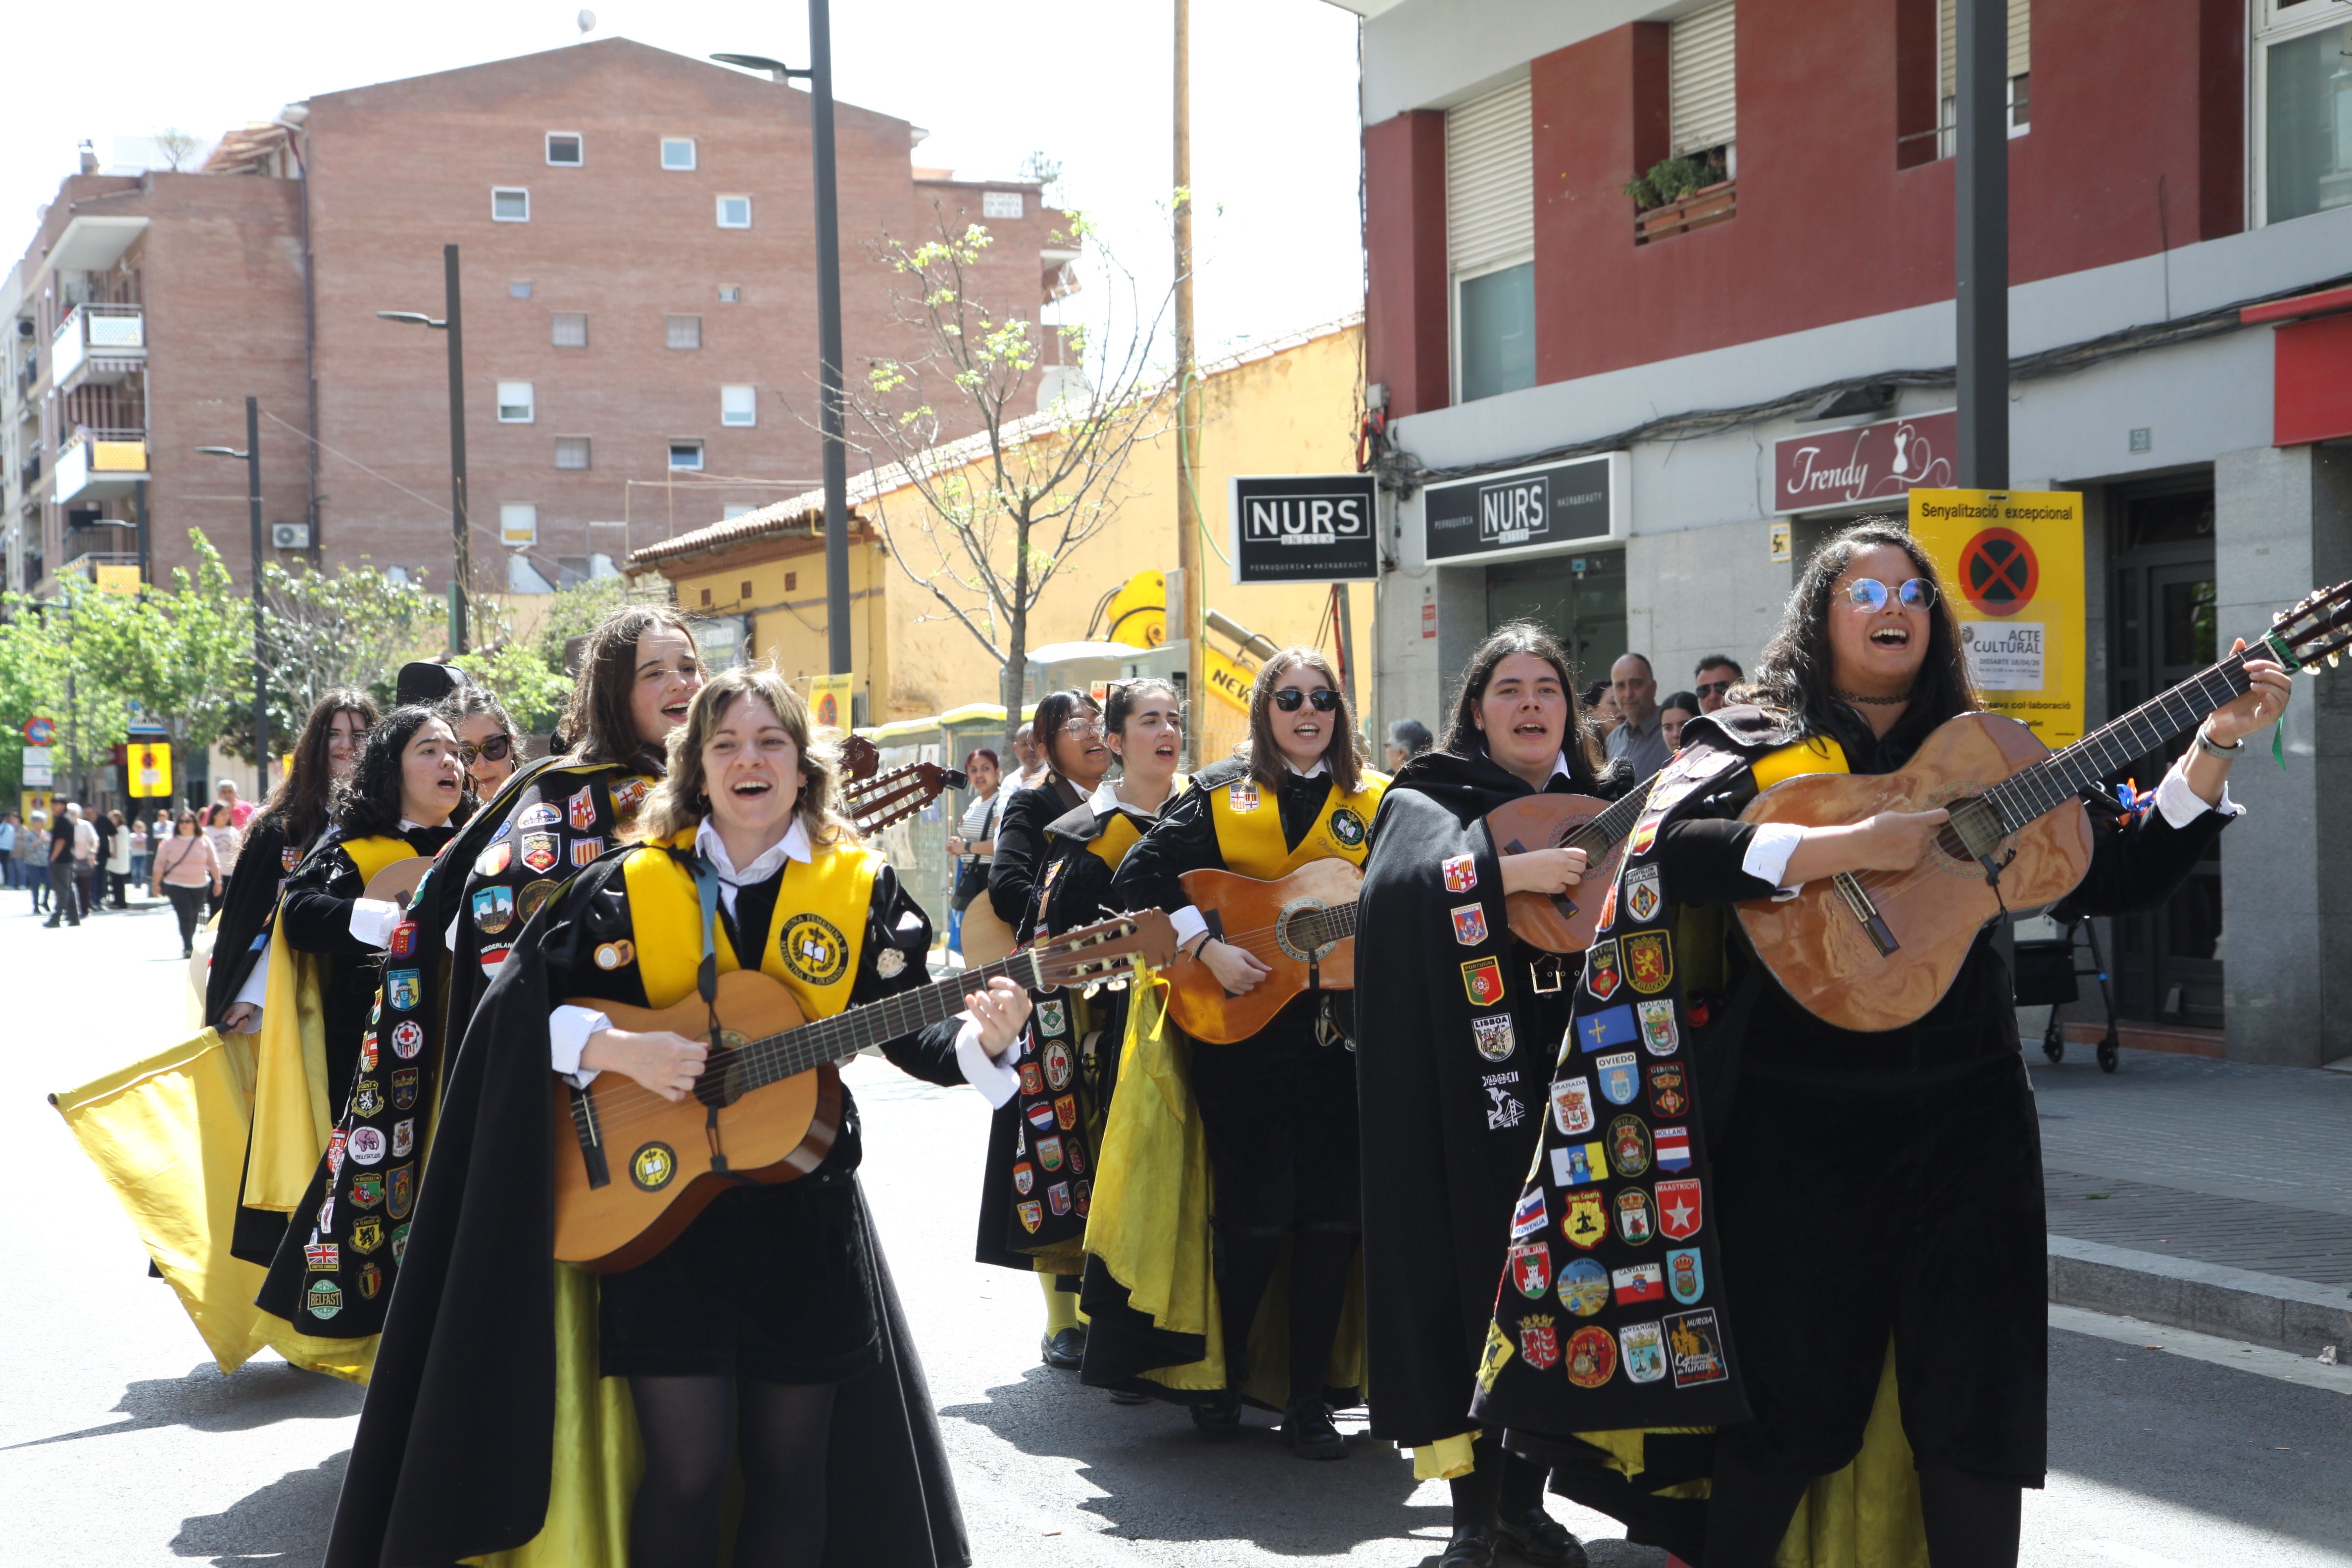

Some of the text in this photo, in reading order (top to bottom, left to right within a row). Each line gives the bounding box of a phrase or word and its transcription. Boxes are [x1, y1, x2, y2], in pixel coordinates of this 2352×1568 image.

[1787, 429, 1870, 501] Trendy
[1557, 492, 1602, 507] HAIR&BEAUTY
[1484, 485, 1543, 534] NURS
[1922, 502, 2072, 522] Senyalització excepcional
[1253, 499, 1360, 536] NURS
[1435, 516, 1473, 530] PERRUQUERIA
[1283, 535, 1331, 543] UNISEX
[2009, 630, 2040, 642] ACTE
[1974, 640, 2041, 654] CULTURAL
[2011, 701, 2071, 709] col·laboració
[807, 914, 843, 943] FEMENINA
[480, 942, 513, 954] NEDERLAN
[1590, 944, 1616, 959] SITGES
[781, 940, 803, 979] MEDICINA
[1465, 960, 1493, 970] PORTUGAL
[1634, 974, 1669, 991] ZARAGOZA
[1640, 999, 1671, 1009] MALAGA
[1475, 1016, 1508, 1028] LISBOA
[1598, 1054, 1634, 1067] OVIEDO
[1651, 1065, 1679, 1074] GIRONA
[1486, 1075, 1510, 1084] TAGIDES
[1552, 1079, 1586, 1092] GRANADA
[1026, 1100, 1049, 1113] NEDERLAND
[1655, 1128, 1685, 1137] HOLLAND
[1658, 1182, 1698, 1192] MAASTRICHT
[1514, 1244, 1547, 1259] LJUBLJANA
[1619, 1264, 1655, 1276] CANTABRIA
[310, 1292, 340, 1307] BELFAST
[1687, 1316, 1713, 1328] MURCIA
[1619, 1324, 1659, 1334] SANTANDER
